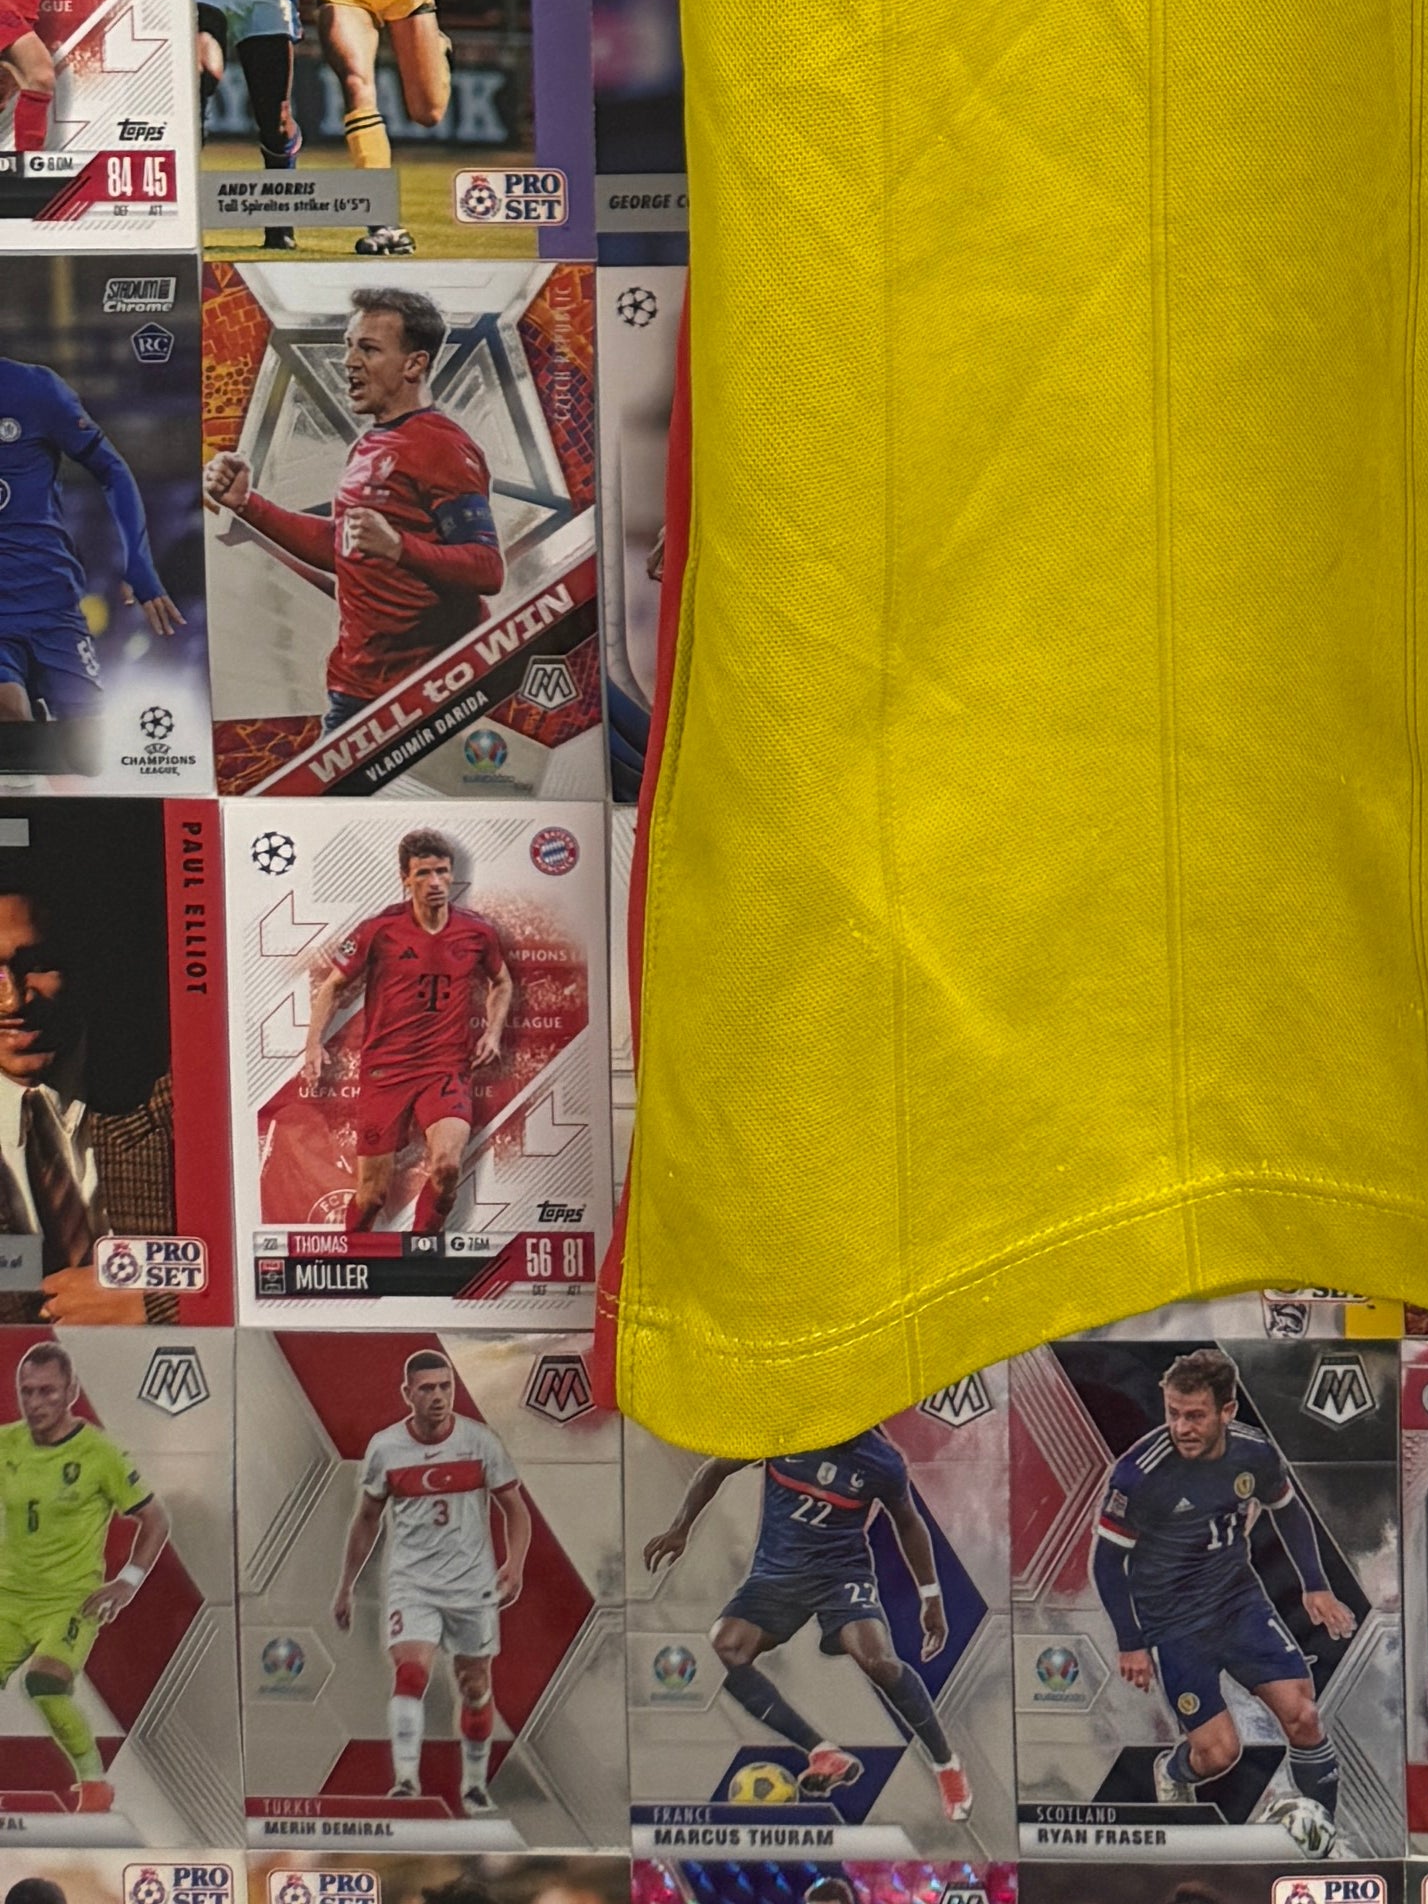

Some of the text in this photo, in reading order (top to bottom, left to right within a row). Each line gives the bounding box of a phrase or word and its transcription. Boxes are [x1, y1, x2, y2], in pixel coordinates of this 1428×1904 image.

[116, 120, 167, 141] topps
[106, 157, 168, 195] 84 45
[504, 173, 561, 195] PRO
[217, 181, 316, 197] ANDY MORRIS
[217, 199, 240, 214] Tall
[243, 198, 298, 216] Spireites
[300, 198, 331, 213] striker
[504, 198, 561, 221] SET
[609, 194, 668, 210] GEORGE
[102, 301, 172, 314] Chrome
[307, 584, 576, 785] WILL to WIN
[365, 691, 490, 783] VLADIMÍR DARIDA
[120, 754, 197, 768] CHAMPIONS
[180, 821, 208, 995] PAUL ELLIOT
[535, 1202, 586, 1224] topps
[145, 1242, 201, 1262] PRO
[293, 1234, 348, 1254] THOMAS
[525, 1241, 585, 1277] 56 81
[145, 1266, 201, 1287] SET
[295, 1261, 369, 1292] MÜLLER
[432, 1499, 449, 1527] 3
[790, 1495, 834, 1528] 22
[1207, 1509, 1238, 1550] 17
[262, 1799, 323, 1816] TURKEY
[653, 1807, 713, 1824] FRANCE
[1036, 1805, 1117, 1824] SCOTLAND
[320, 1820, 395, 1838] DEMIRAL
[654, 1827, 834, 1847] MARCUS THURAM
[1036, 1827, 1167, 1847] RYAN FRASER
